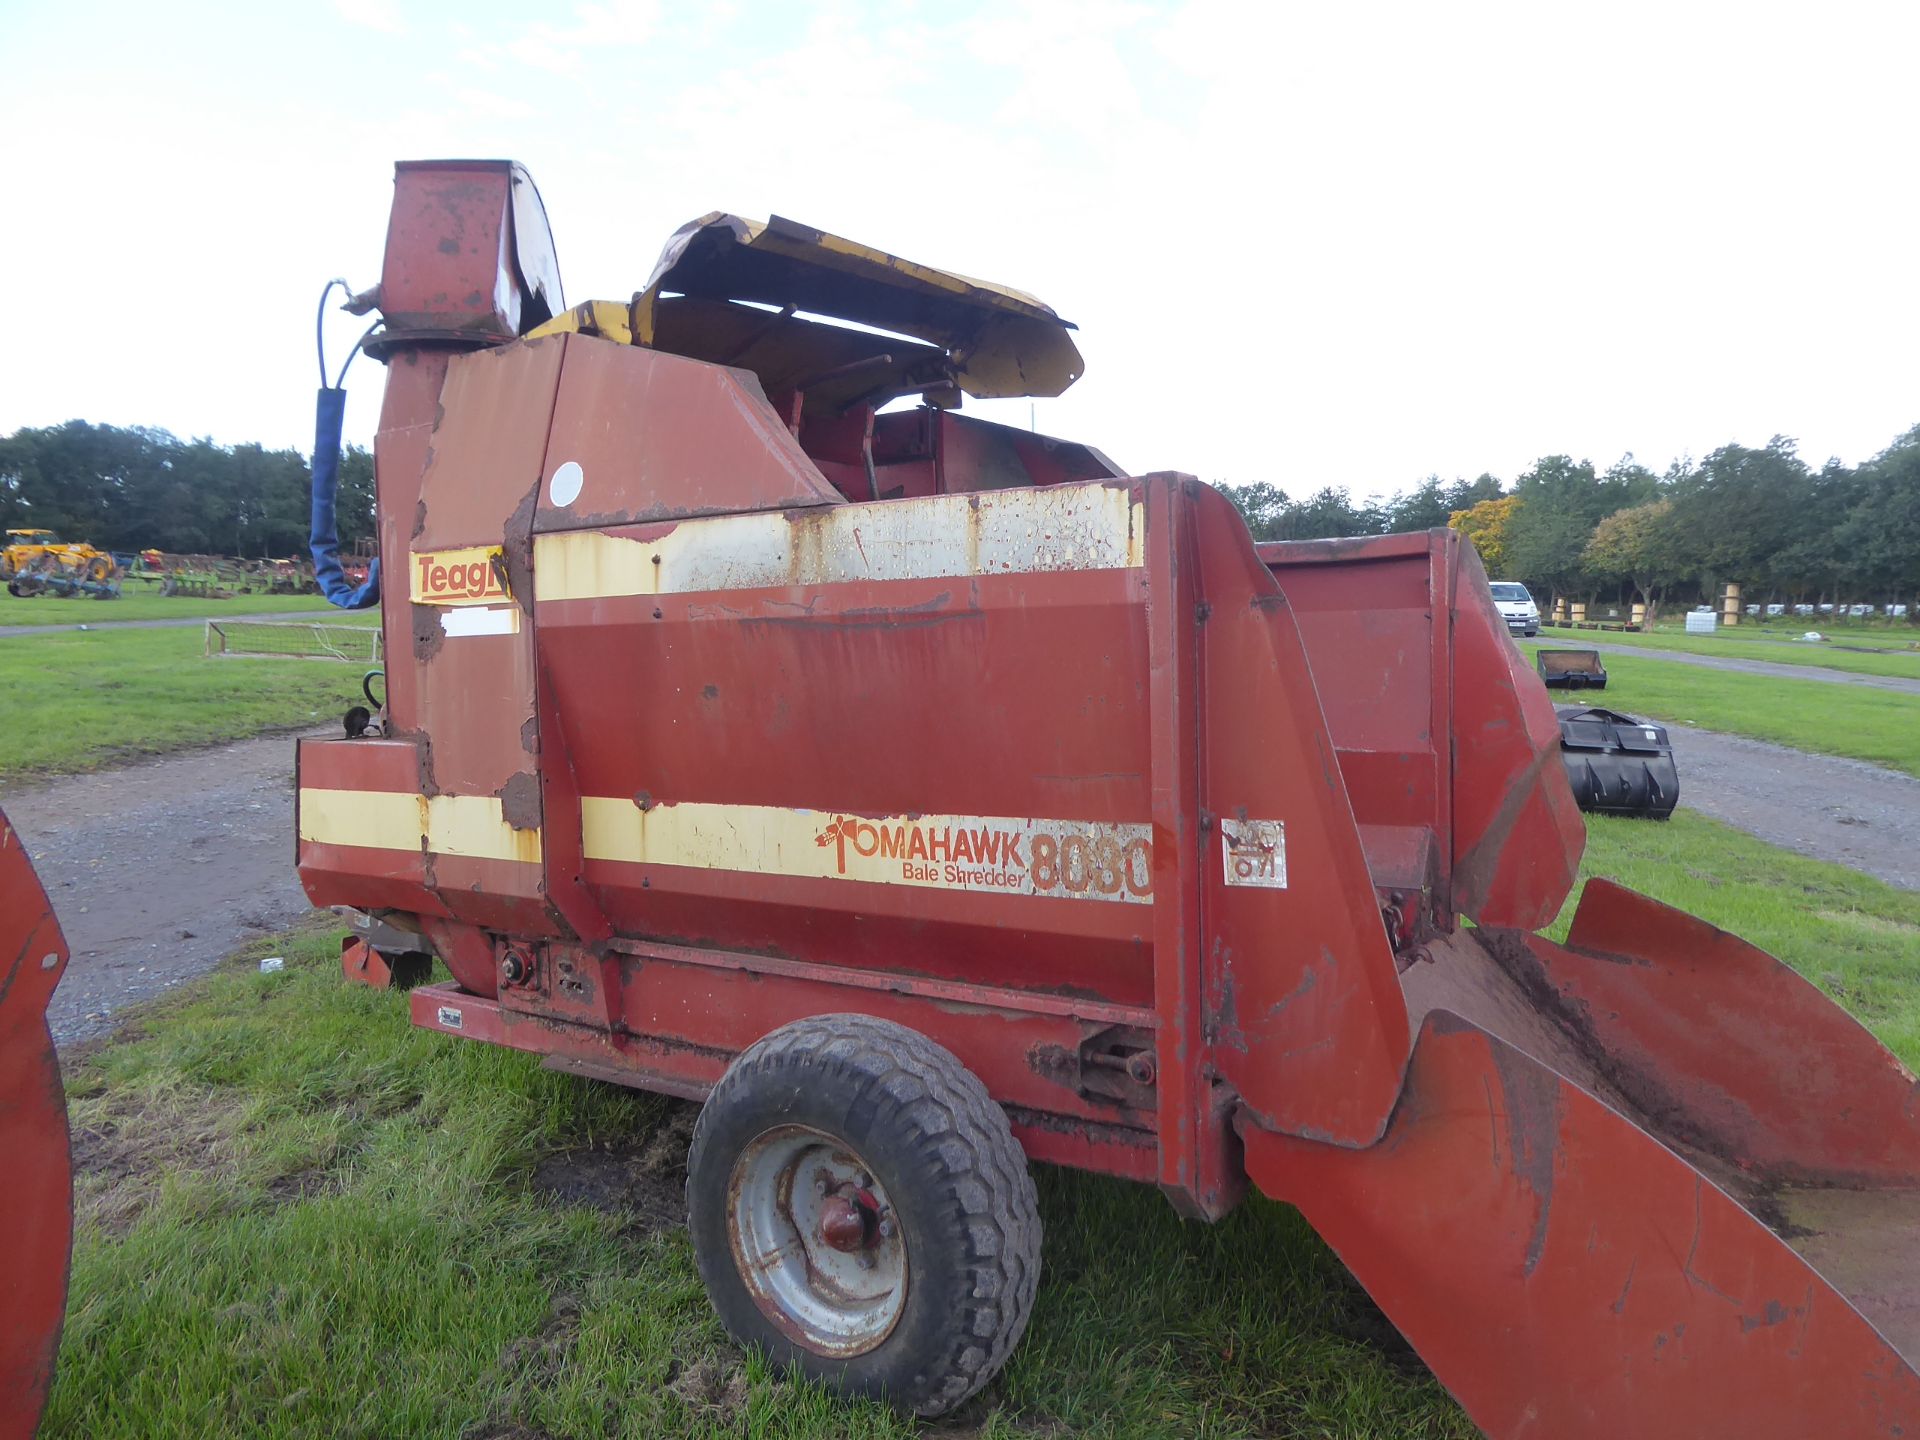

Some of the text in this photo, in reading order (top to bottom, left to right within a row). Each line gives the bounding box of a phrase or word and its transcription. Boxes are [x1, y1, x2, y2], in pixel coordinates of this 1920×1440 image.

[902, 862, 1025, 888] Bale Shredder
[1030, 833, 1153, 897] 8080
